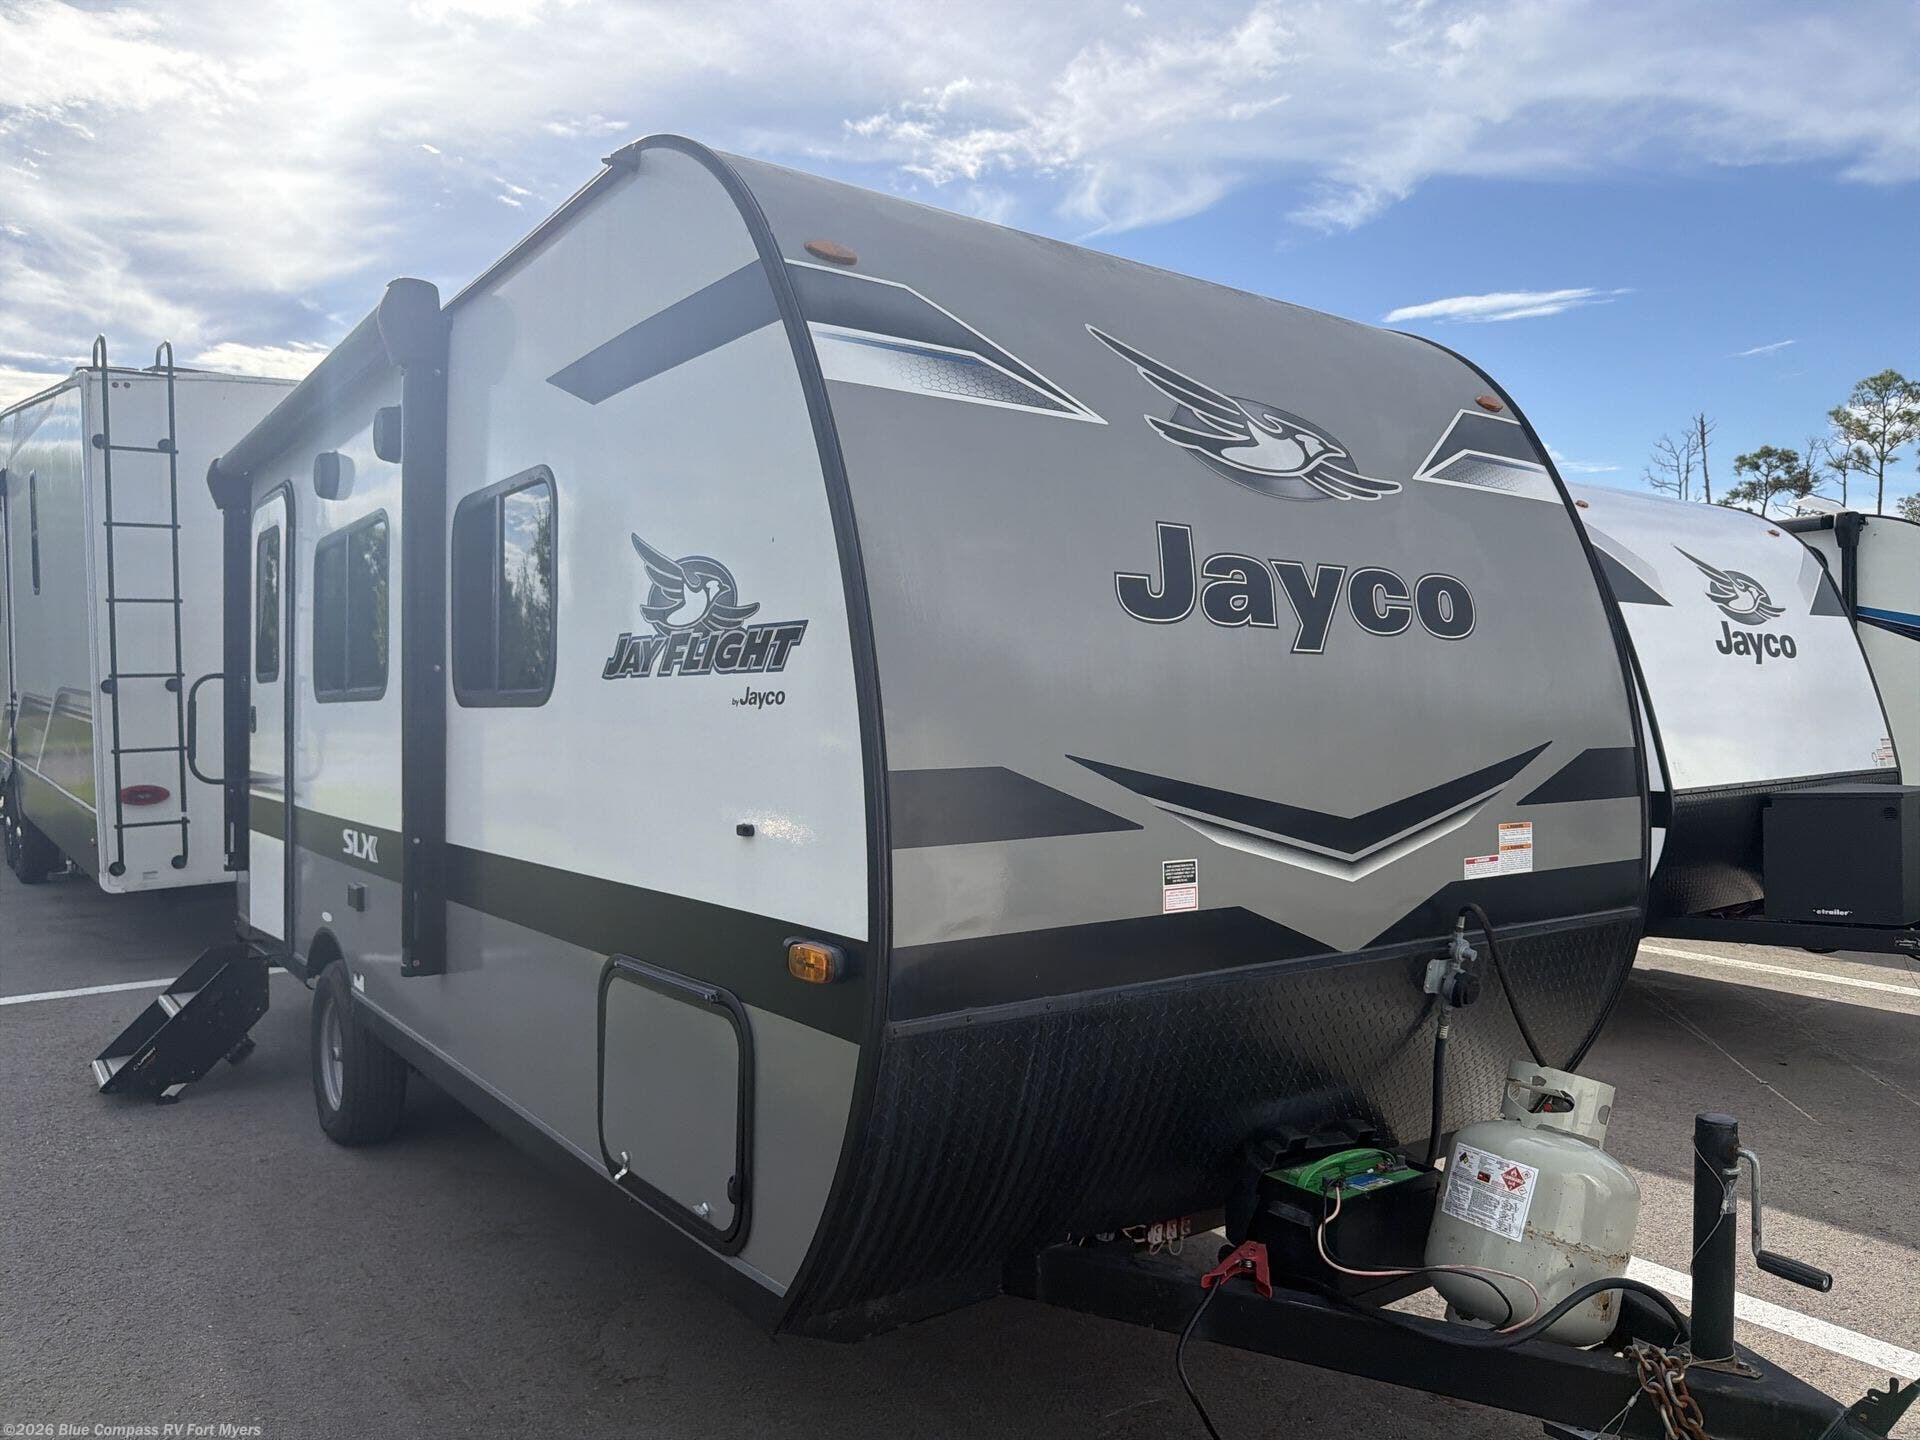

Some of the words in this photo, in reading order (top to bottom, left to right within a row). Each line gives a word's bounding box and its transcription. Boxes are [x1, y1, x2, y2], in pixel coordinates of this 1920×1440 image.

[1114, 520, 1476, 655] Jayco
[602, 632, 666, 680] JAY
[657, 619, 809, 678] FLIGHT
[1715, 620, 1797, 665] Jayco
[731, 697, 739, 707] by
[739, 686, 786, 710] Jayco
[342, 828, 379, 864] SLX
[1815, 908, 1850, 917] etrailer
